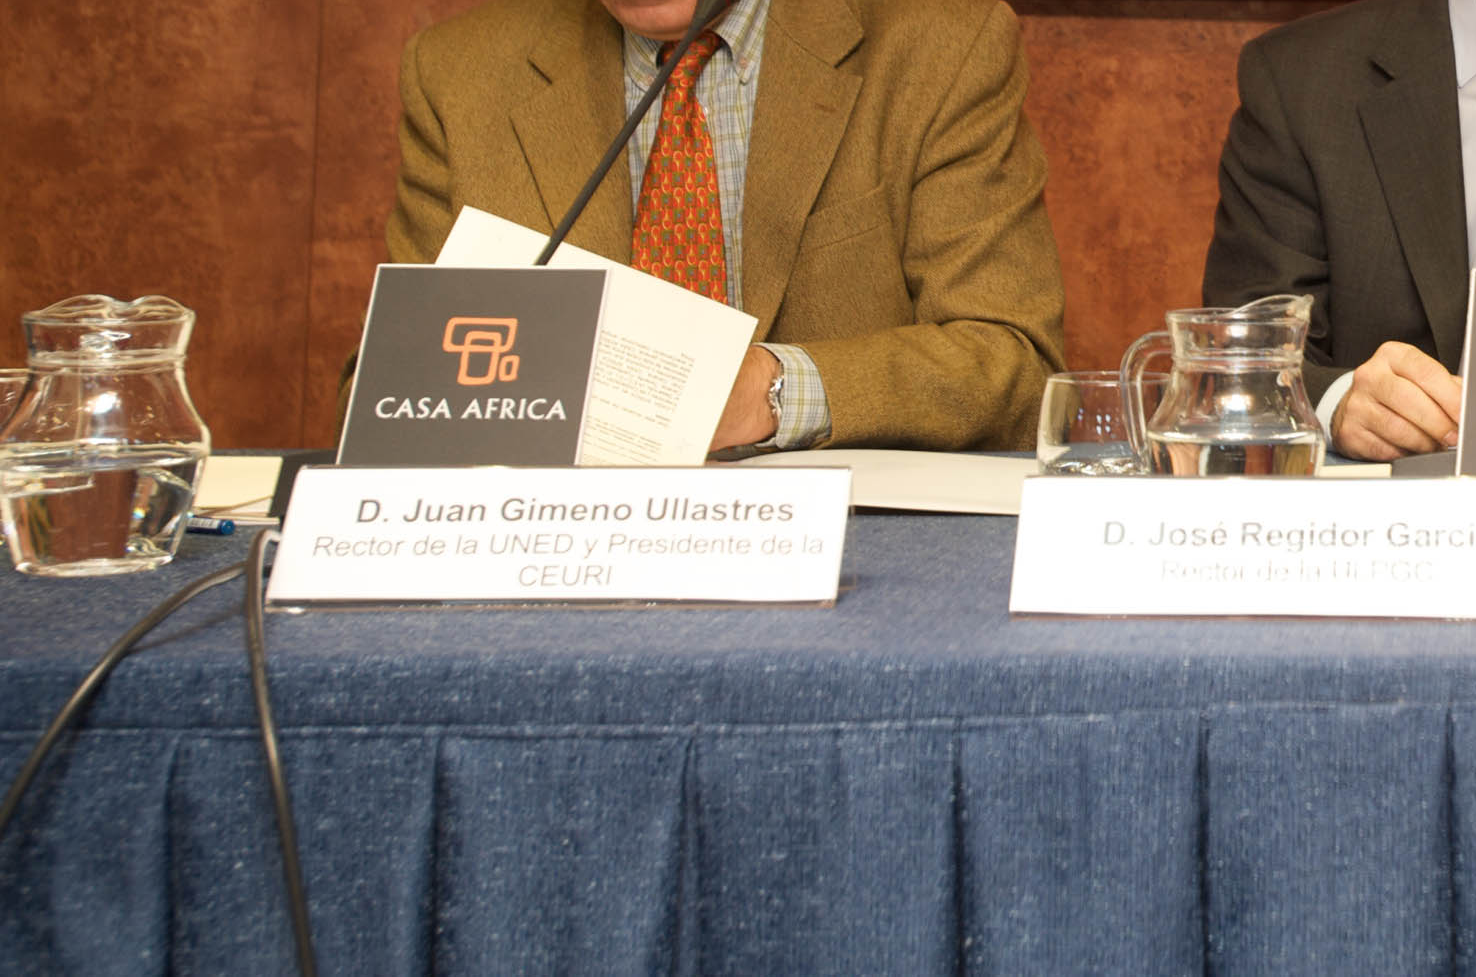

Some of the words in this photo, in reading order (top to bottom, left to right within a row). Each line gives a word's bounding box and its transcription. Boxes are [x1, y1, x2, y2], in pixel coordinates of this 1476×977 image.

[375, 396, 452, 420] CASA
[460, 397, 567, 420] AFRICA
[356, 499, 389, 523] D.
[403, 499, 486, 523] Juan
[501, 497, 632, 522] Gimeno
[646, 497, 793, 522] Ullastres
[312, 535, 403, 557] Rector
[412, 534, 446, 556] de
[455, 534, 478, 555] la
[489, 532, 573, 555] UNED
[584, 538, 599, 559] y
[608, 533, 751, 555] Presidente
[760, 533, 793, 555] de
[802, 533, 824, 555] la
[1101, 520, 1134, 547] D.
[1148, 518, 1229, 547] José
[1240, 520, 1374, 554] Regidor
[518, 564, 613, 587] CEURI
